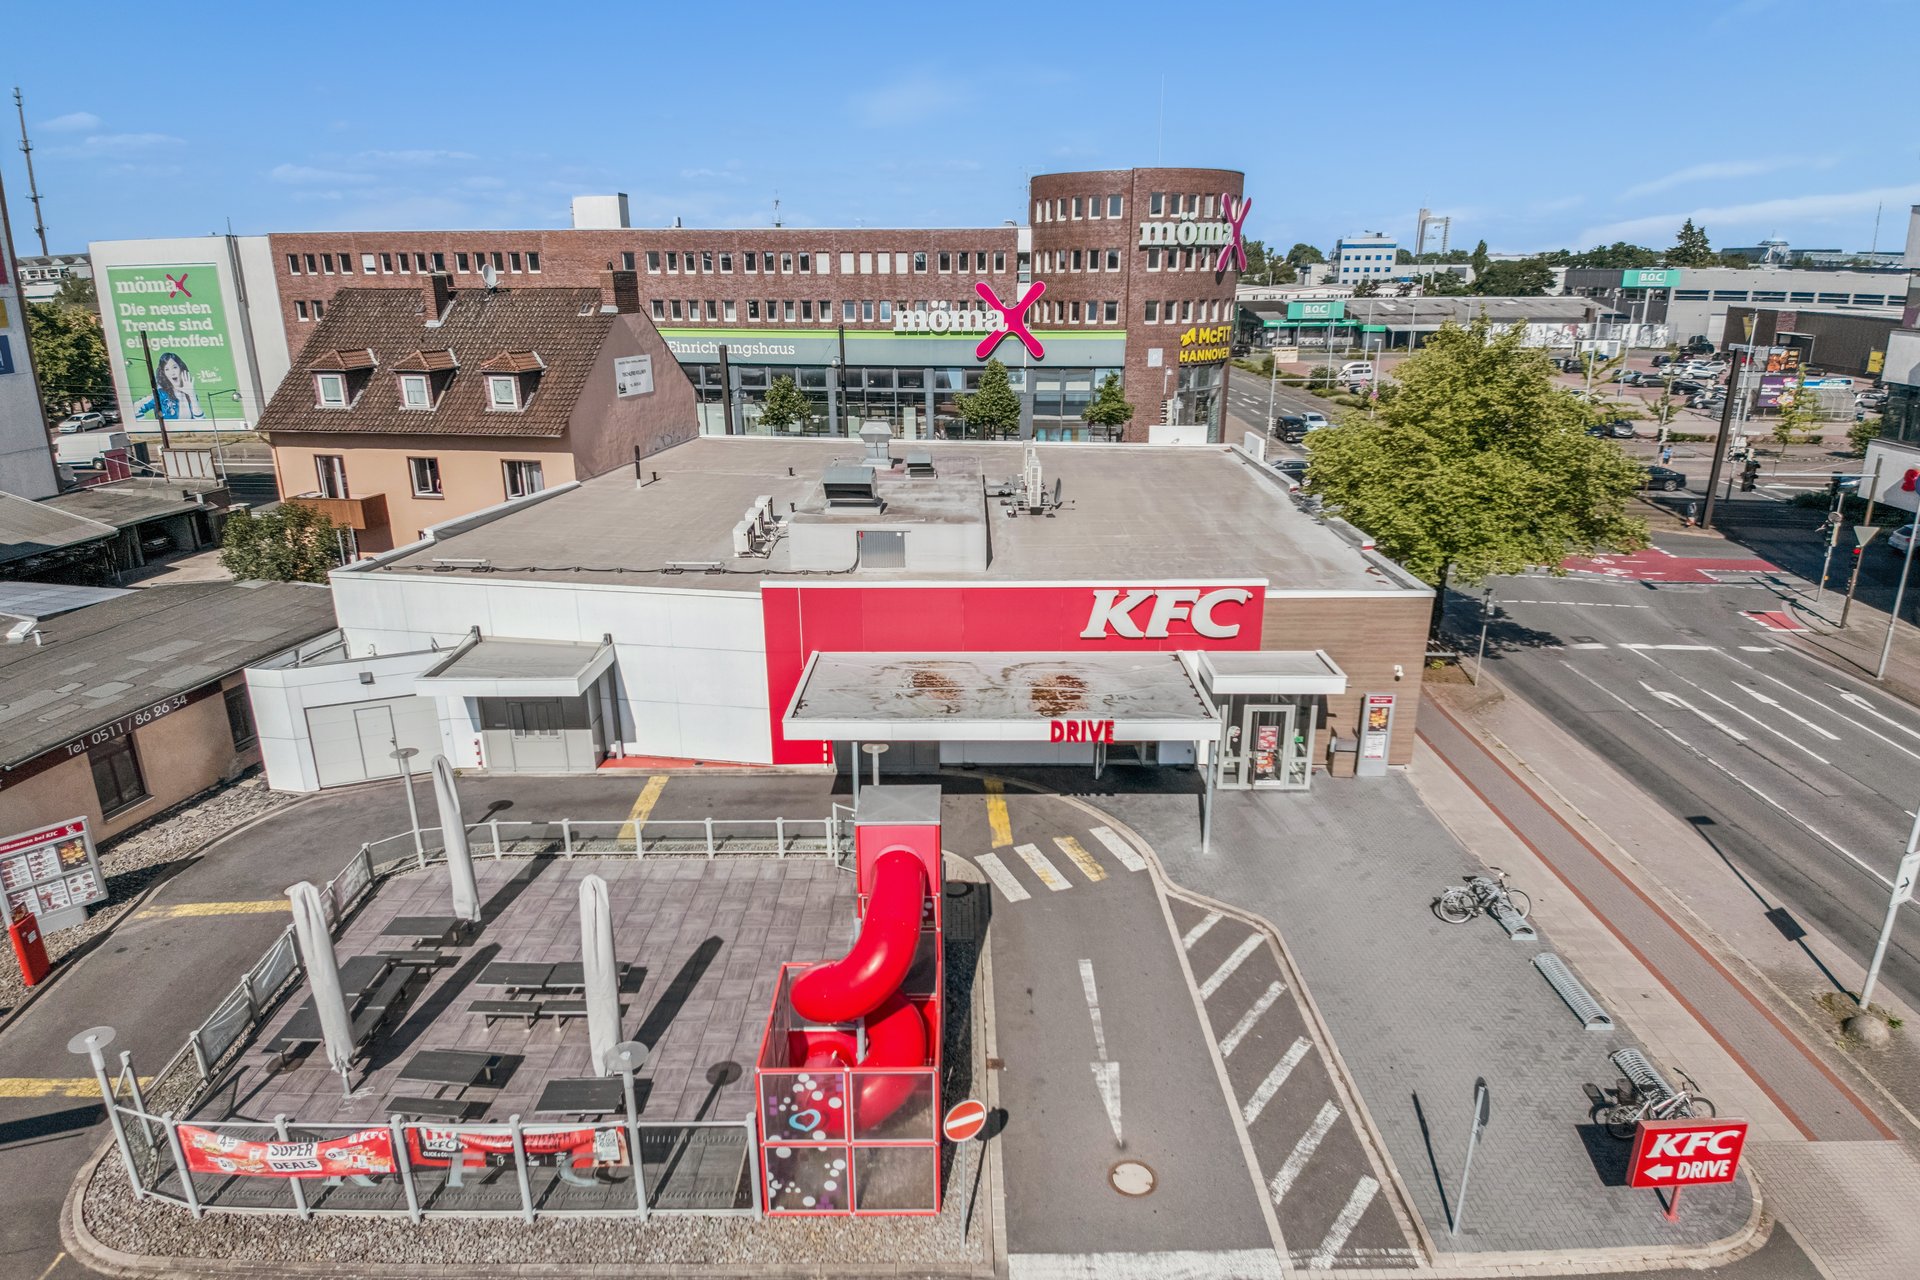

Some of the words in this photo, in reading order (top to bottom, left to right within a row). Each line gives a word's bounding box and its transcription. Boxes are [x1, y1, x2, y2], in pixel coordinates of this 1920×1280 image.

[119, 302, 146, 316] Die
[149, 301, 212, 316] neusten
[122, 318, 176, 332] Trends
[178, 317, 213, 331] sind
[1198, 325, 1232, 345] McFIT
[668, 341, 796, 358] Einrichungshaus
[1179, 347, 1230, 362] HANNOVER
[1080, 588, 1251, 639] KFC
[65, 740, 89, 756] Tel.
[91, 722, 123, 745] 0511
[135, 710, 152, 725] 86
[153, 702, 170, 717] 26
[171, 694, 188, 709] 34
[1050, 719, 1115, 744] DRIVE
[358, 1130, 388, 1143] KFC
[1645, 1130, 1742, 1158] KFC
[271, 1142, 314, 1157] SUPER
[272, 1160, 318, 1170] DEALS
[1676, 1159, 1731, 1180] DRIVE
